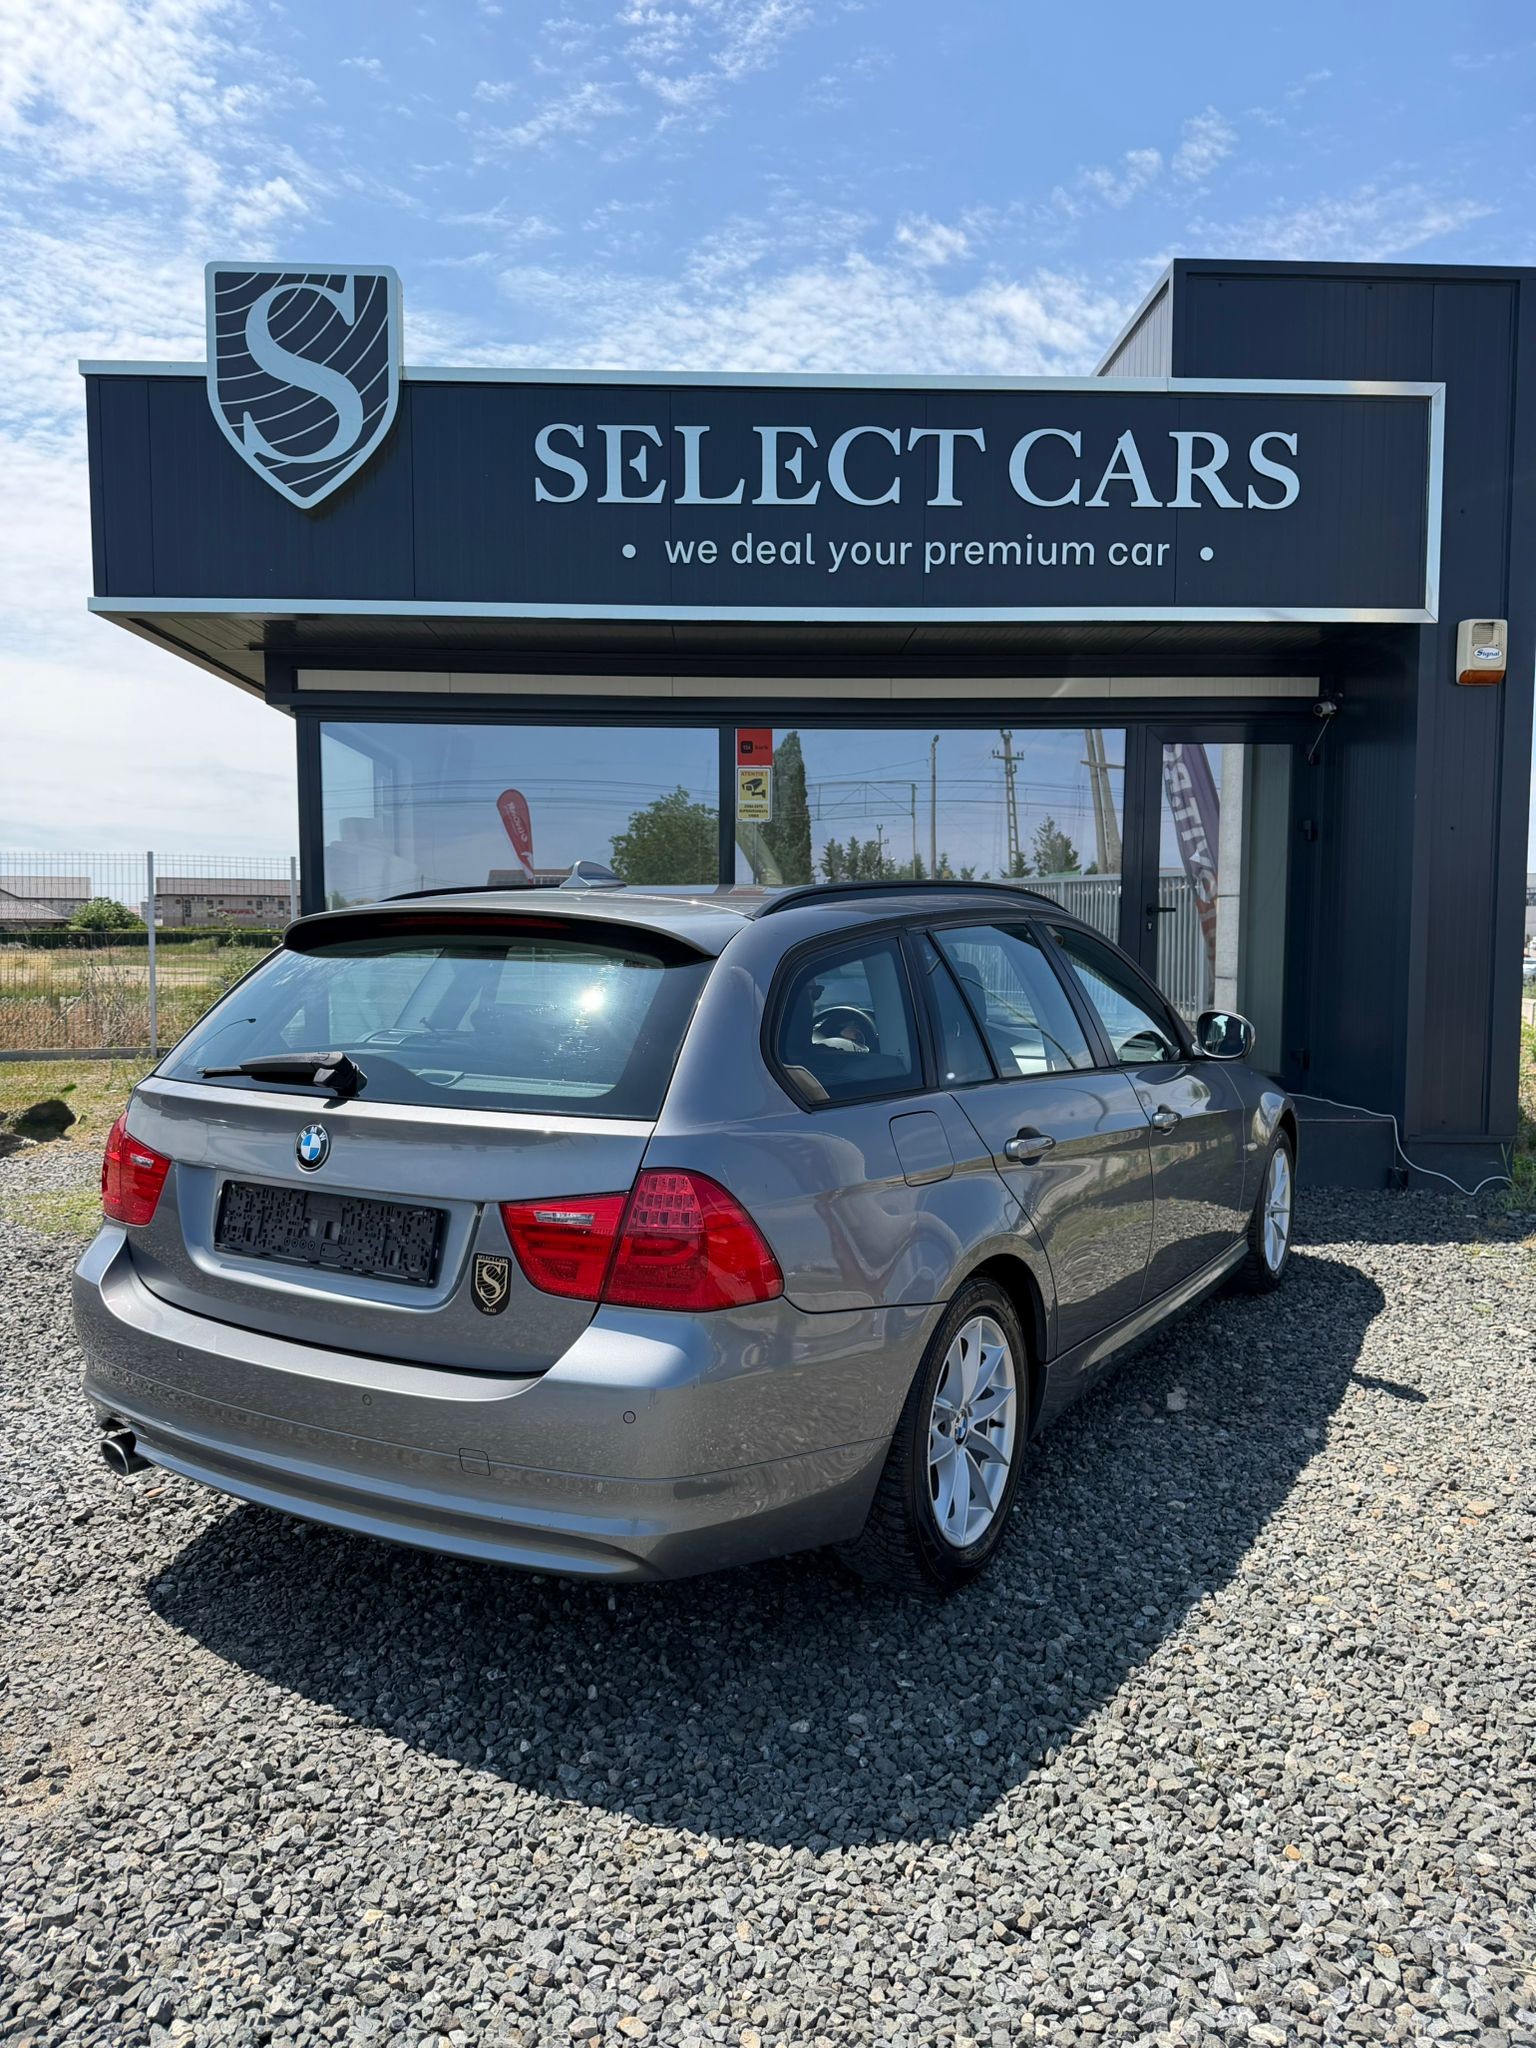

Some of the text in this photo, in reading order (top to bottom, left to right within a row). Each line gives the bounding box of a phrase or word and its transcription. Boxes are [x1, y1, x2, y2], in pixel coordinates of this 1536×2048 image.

[534, 423, 1301, 511] SELECT CARS
[664, 532, 1170, 574] we deal your premium car
[300, 1126, 327, 1142] BMW
